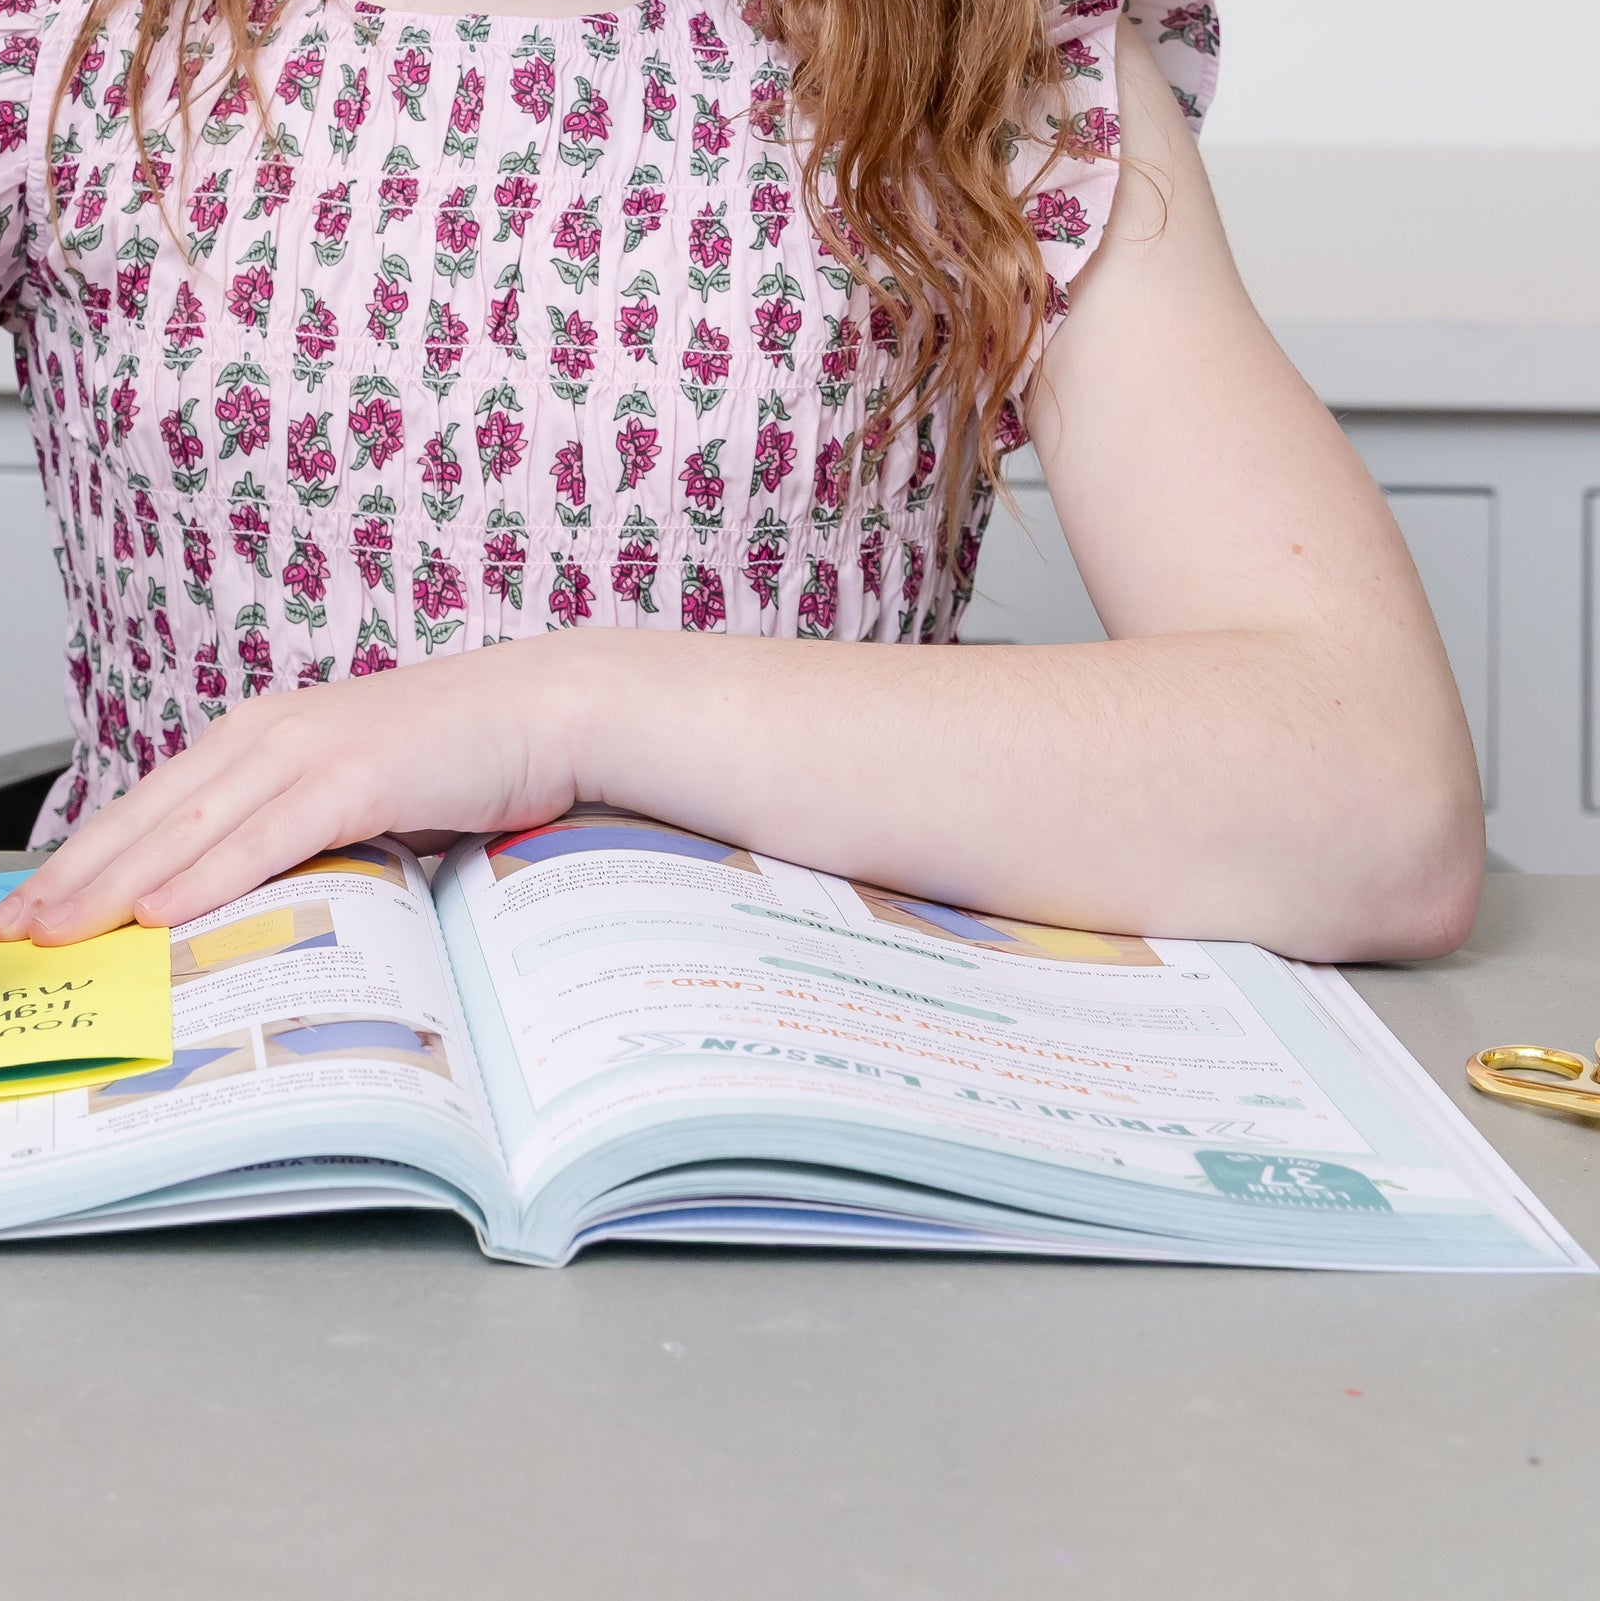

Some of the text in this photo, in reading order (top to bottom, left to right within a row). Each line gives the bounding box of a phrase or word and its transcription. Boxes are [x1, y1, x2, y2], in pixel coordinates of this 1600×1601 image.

[766, 911, 946, 961] INSTRUCTIONS
[2, 979, 94, 1002] my
[832, 972, 946, 1008] SUPPLIES
[671, 978, 1134, 1073] LIGHTHOUSE POP-UP CARD
[778, 1019, 1091, 1096] BOOK DISCUSSION
[699, 1038, 1198, 1137] PROJECT LESSON
[1245, 1182, 1351, 1201] LESSON
[1259, 1165, 1327, 1190] 37
